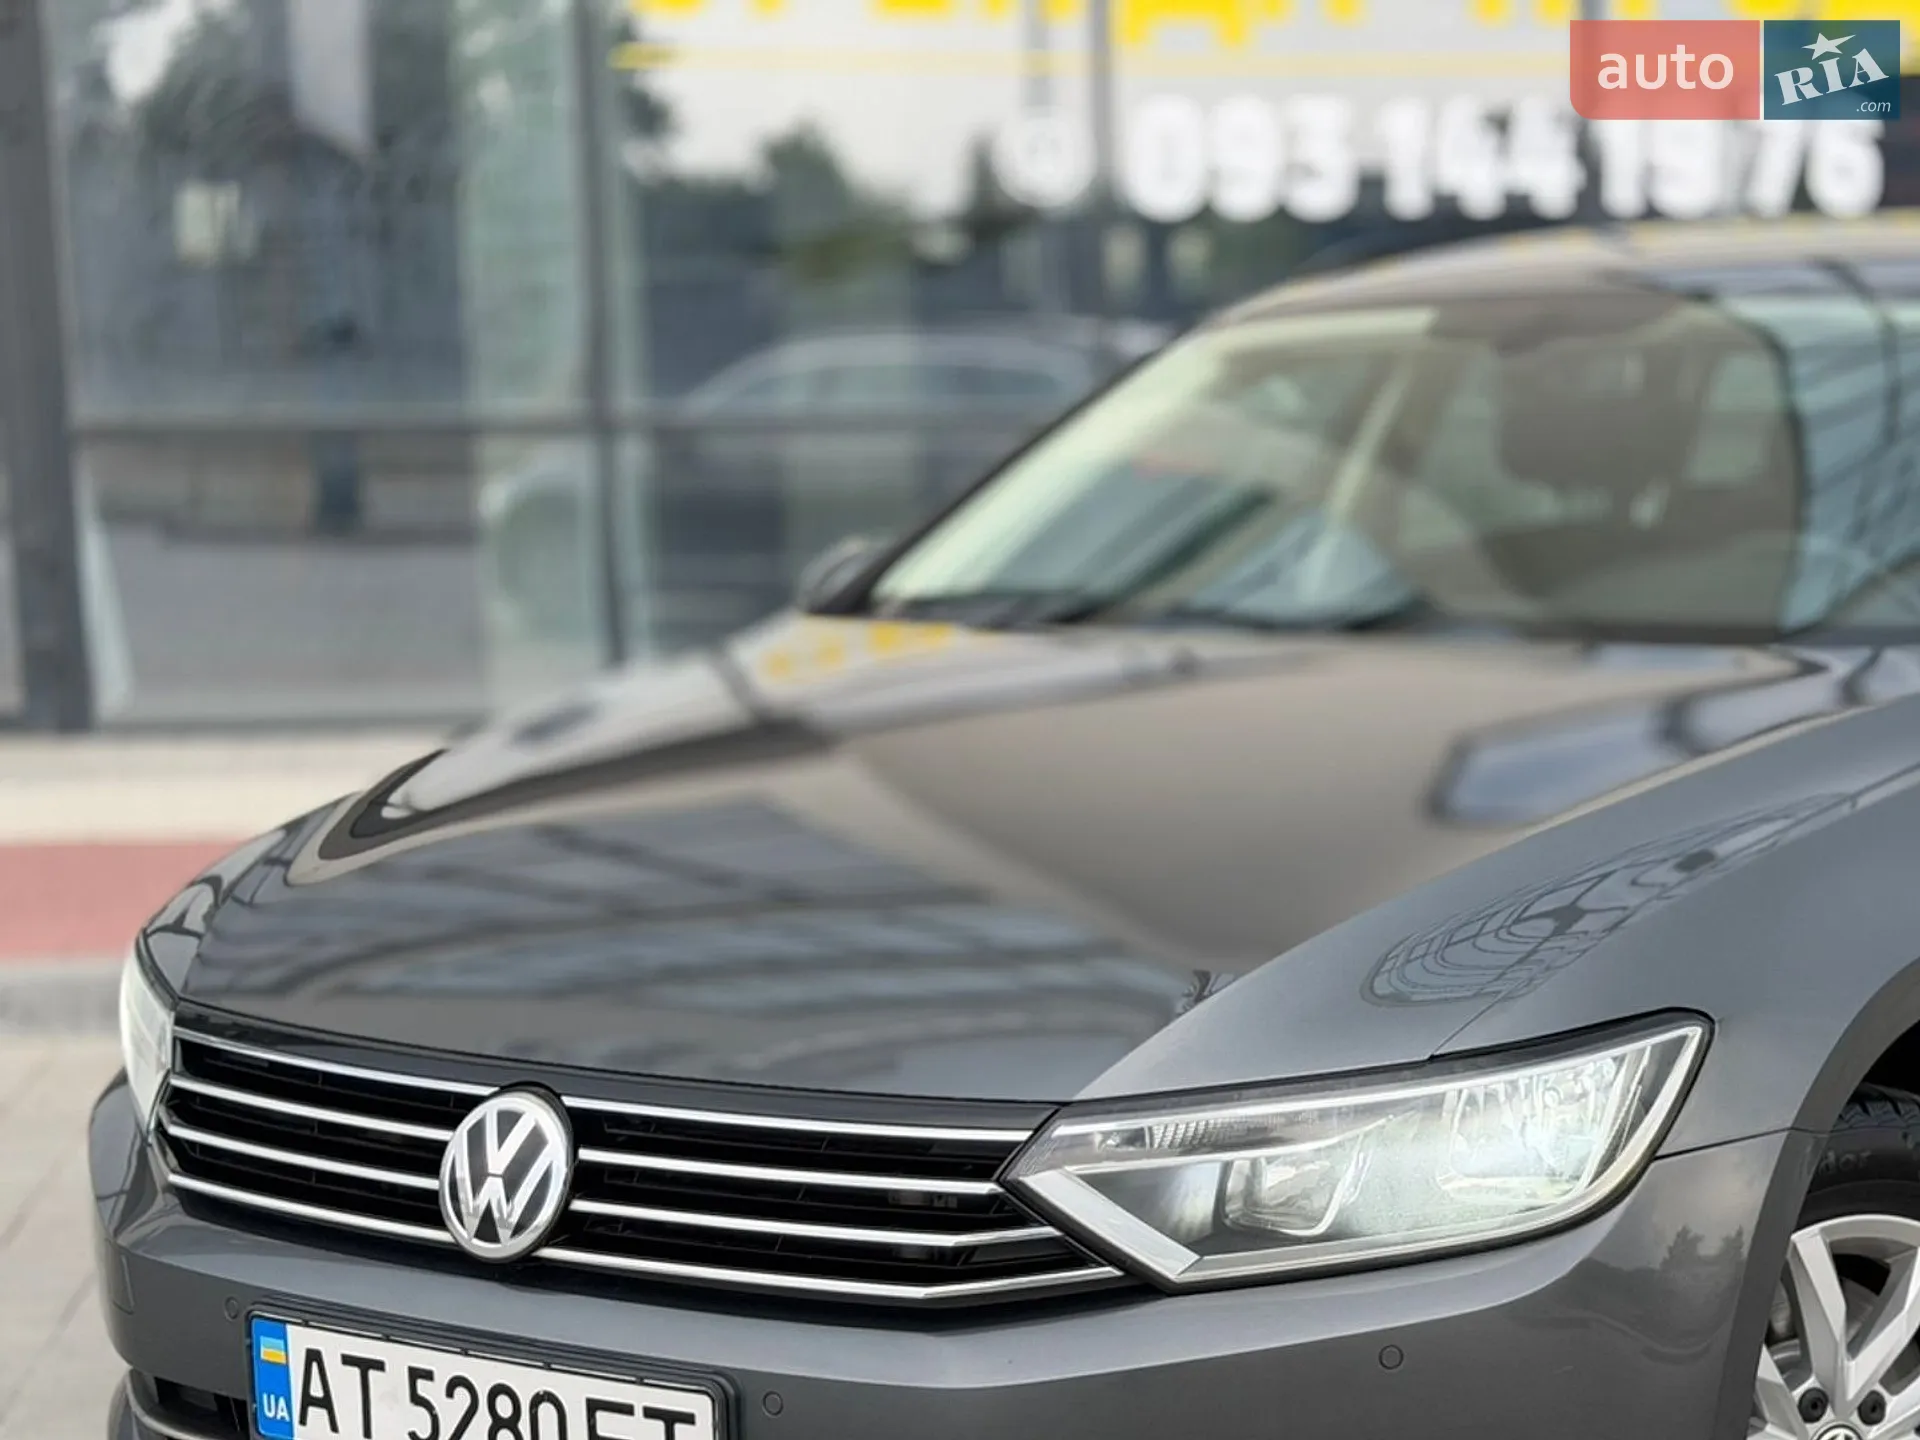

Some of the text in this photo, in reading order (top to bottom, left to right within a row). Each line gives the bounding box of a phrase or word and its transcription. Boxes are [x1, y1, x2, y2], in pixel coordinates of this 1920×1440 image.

[262, 1392, 291, 1422] UA
[298, 1347, 387, 1440] AT
[407, 1365, 568, 1440] 5280
